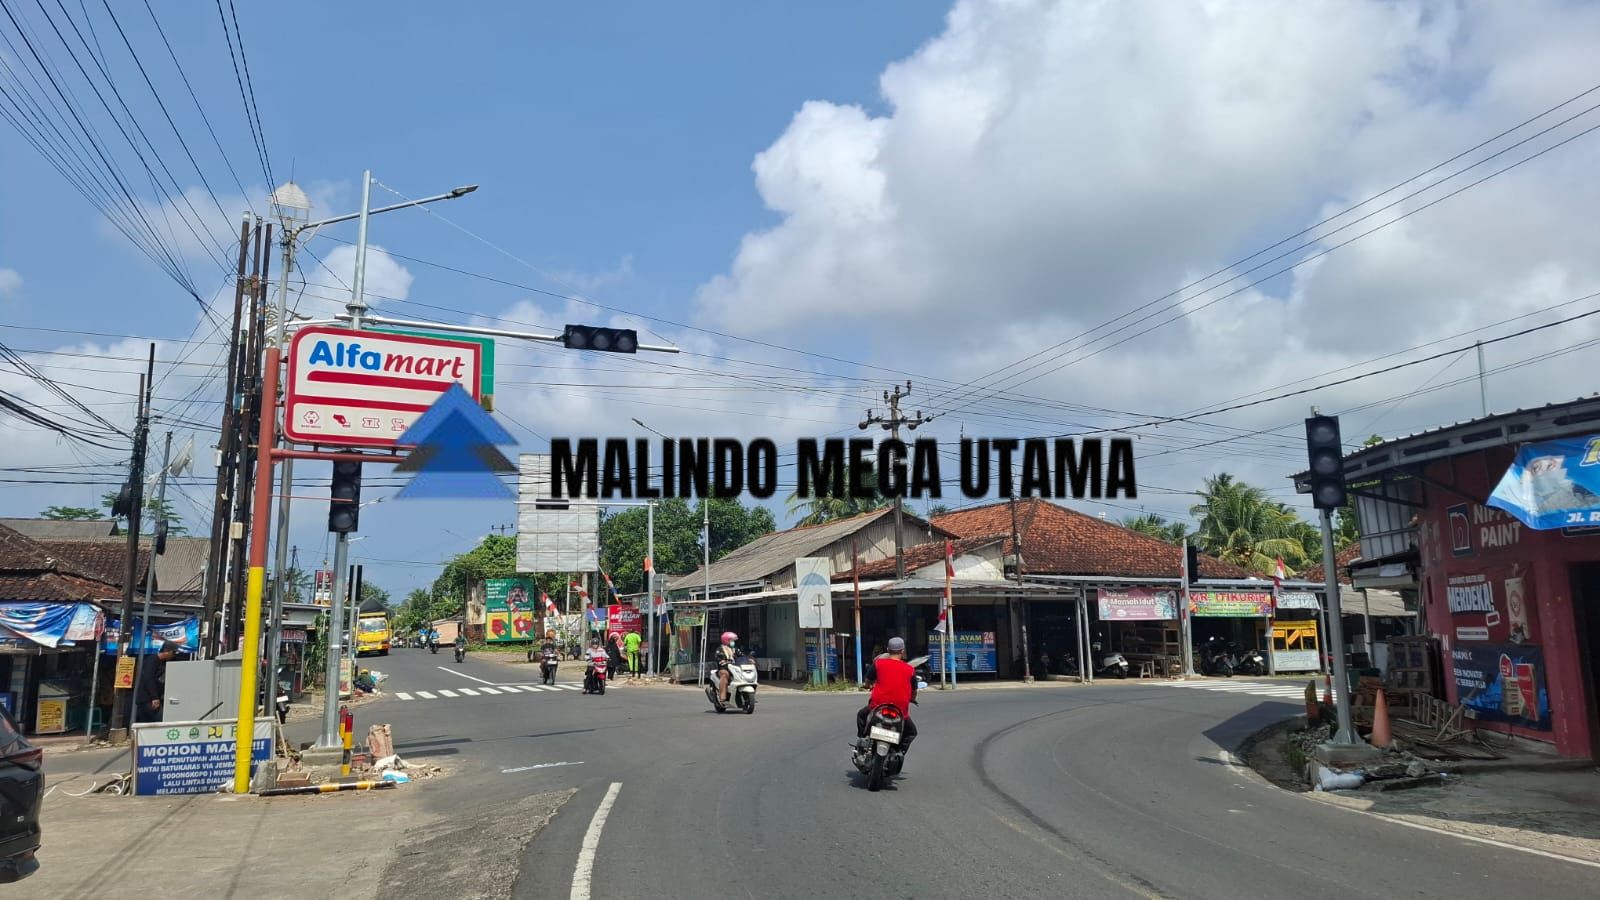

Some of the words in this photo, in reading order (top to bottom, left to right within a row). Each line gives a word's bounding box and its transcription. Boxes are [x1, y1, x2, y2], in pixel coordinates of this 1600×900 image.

[309, 340, 465, 378] Alfamart
[1481, 521, 1520, 549] PAINT
[1448, 581, 1494, 613] MERDEKA!
[144, 745, 201, 757] MOHON
[206, 742, 236, 754] MAA
[167, 755, 207, 764] PENUTUPAN
[208, 754, 230, 762] JALUR
[160, 763, 201, 772] BATUKARAS
[163, 779, 181, 787] LALU
[182, 777, 205, 786] LINTAS
[156, 786, 185, 794] MELALUI
[186, 785, 208, 793] JALUR
